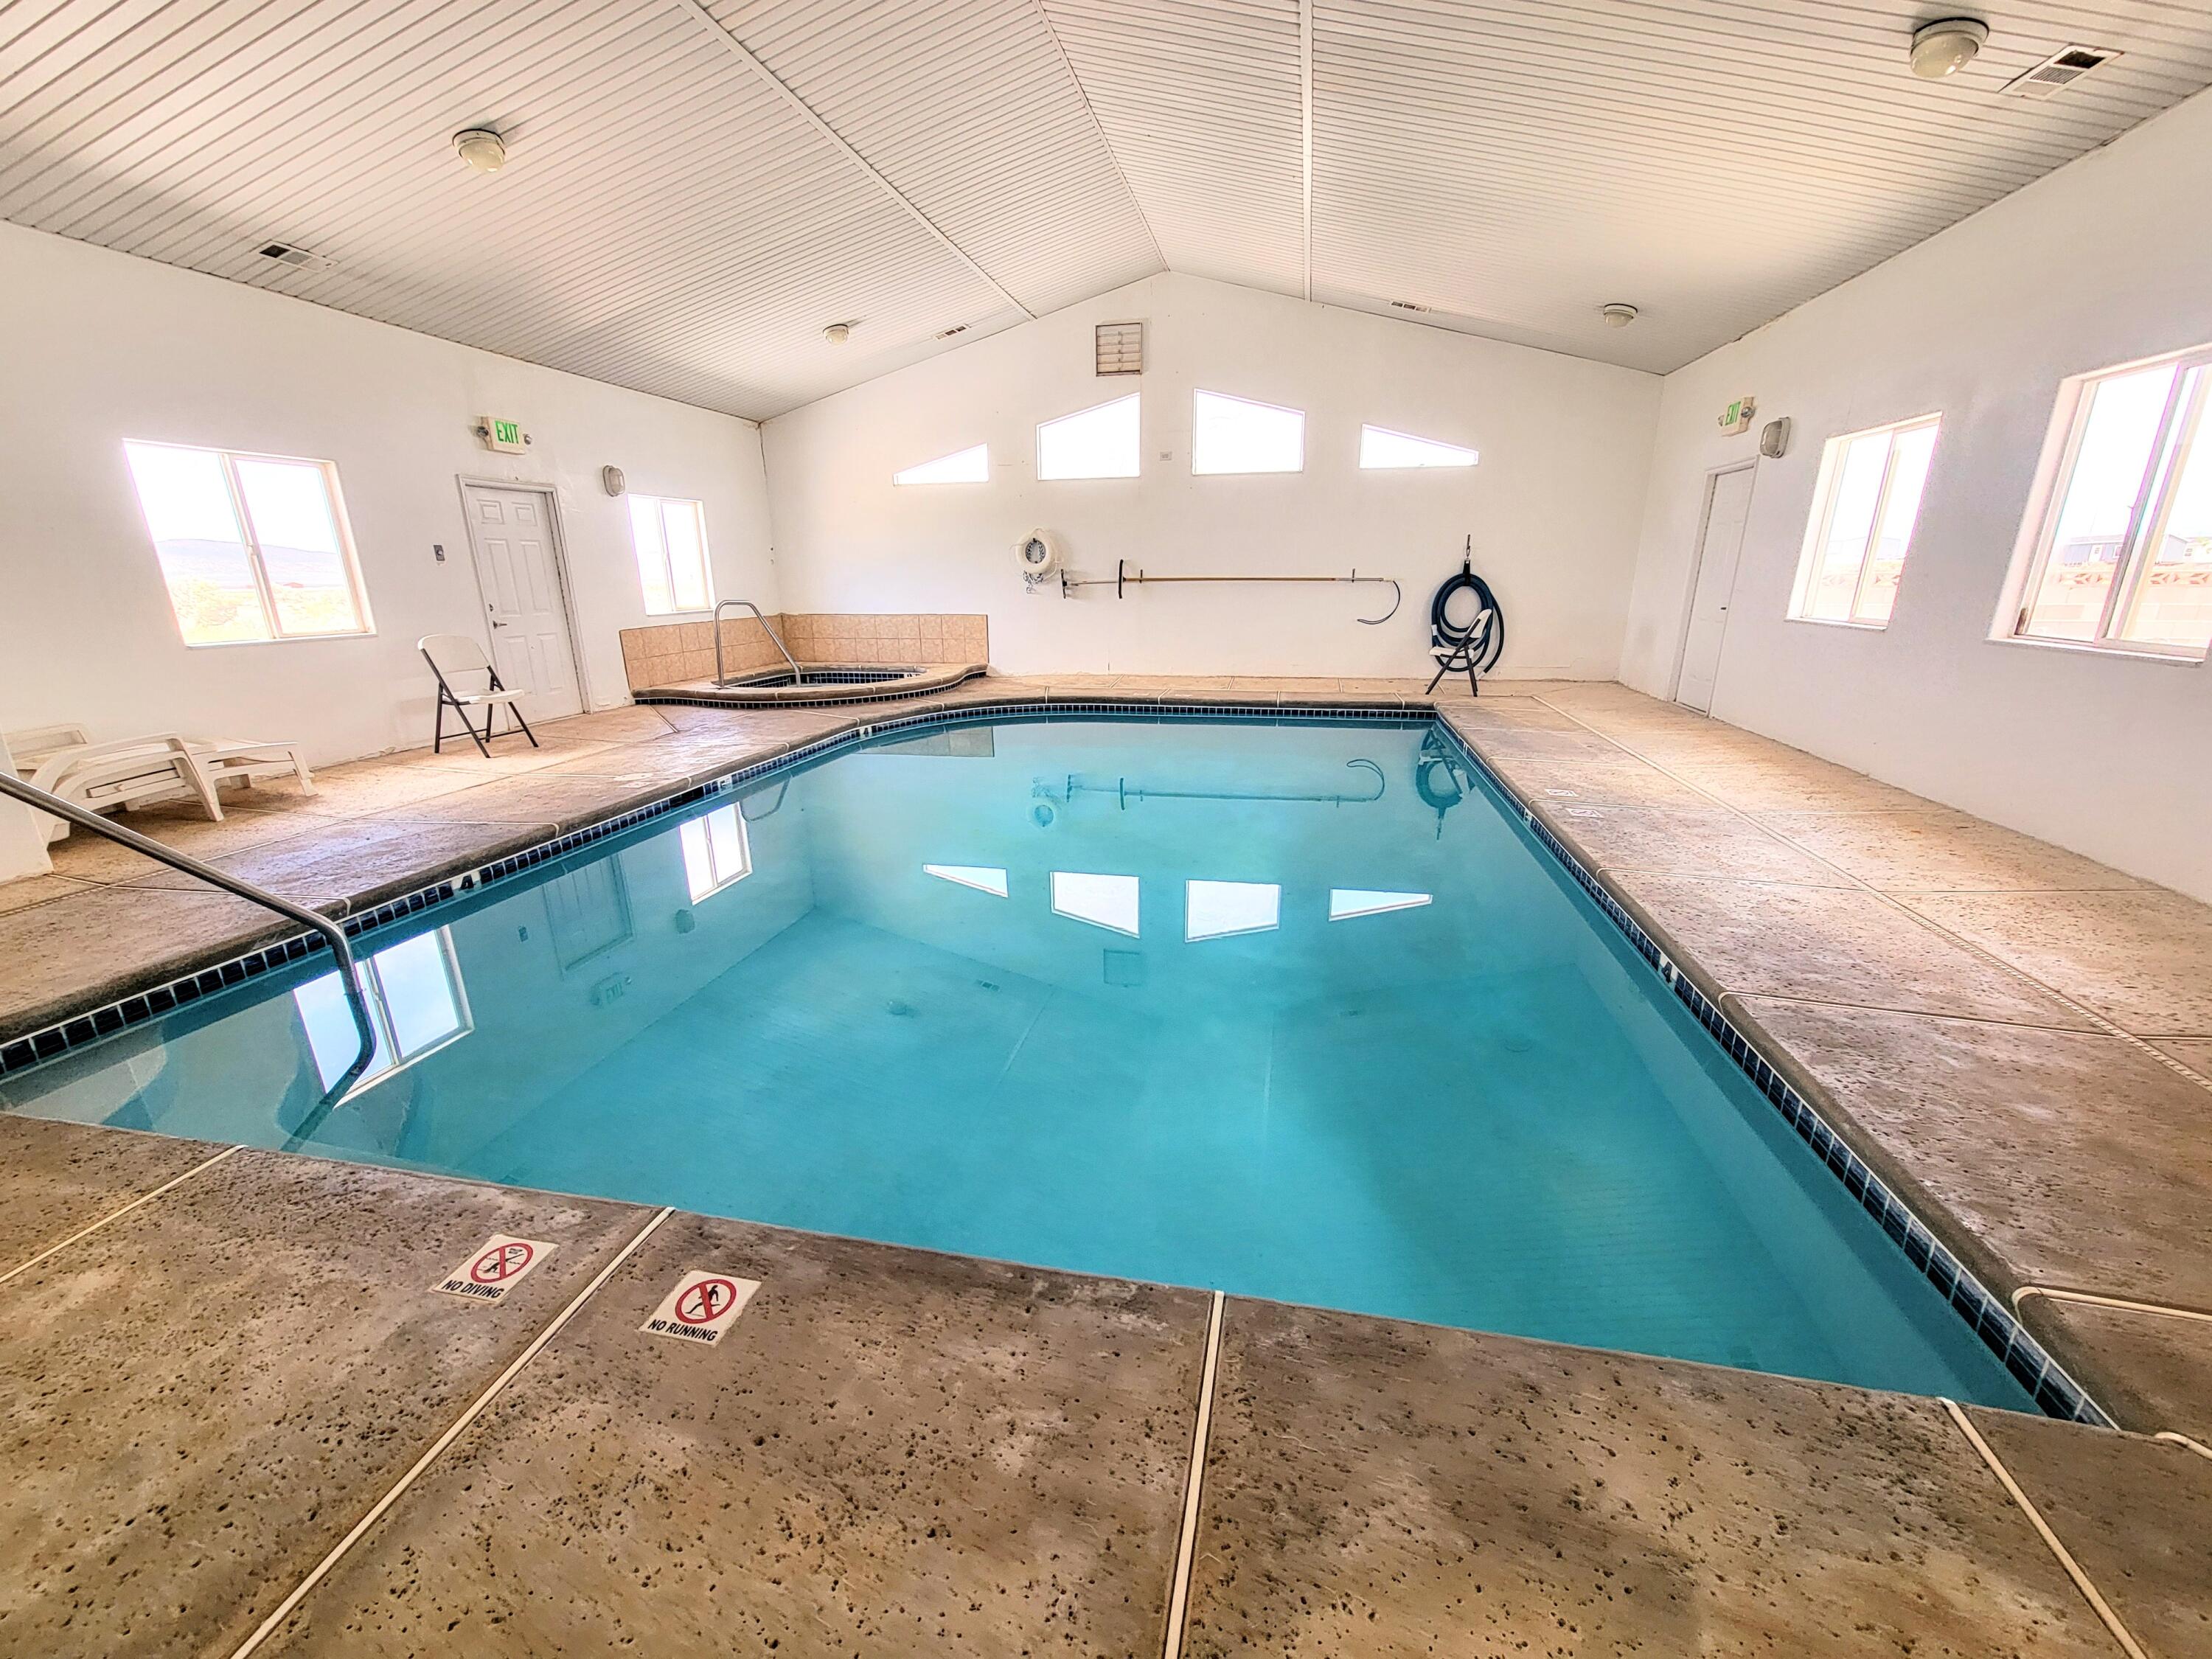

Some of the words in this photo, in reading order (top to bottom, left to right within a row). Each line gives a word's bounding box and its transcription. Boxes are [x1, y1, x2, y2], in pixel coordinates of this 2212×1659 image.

[495, 420, 519, 444] EXIT
[442, 1280, 463, 1291] NO
[460, 1283, 504, 1298] DIVING
[647, 1319, 667, 1331] NO
[665, 1323, 717, 1341] RUNNING
